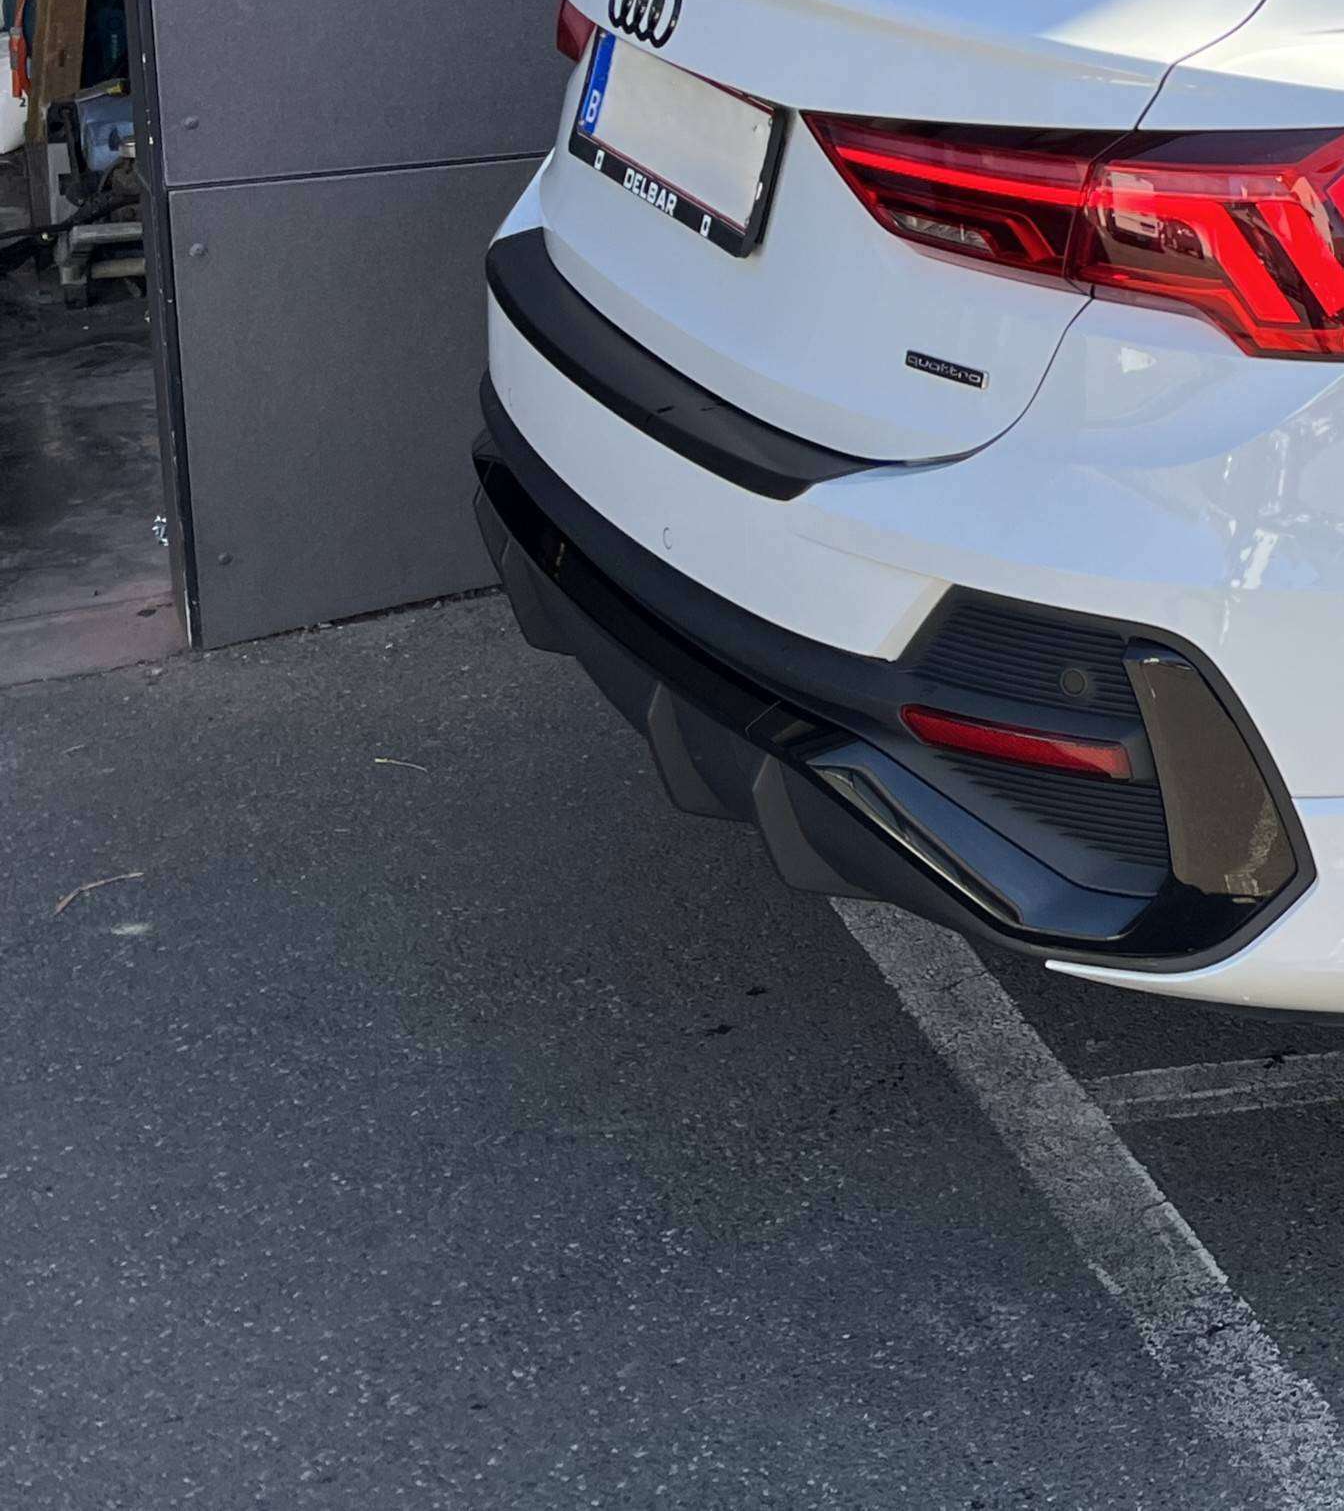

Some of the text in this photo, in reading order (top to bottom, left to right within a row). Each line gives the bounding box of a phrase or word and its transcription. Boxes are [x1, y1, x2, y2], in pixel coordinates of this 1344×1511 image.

[585, 90, 600, 123] B
[622, 167, 678, 217] DELBAR
[907, 354, 981, 383] quattro
